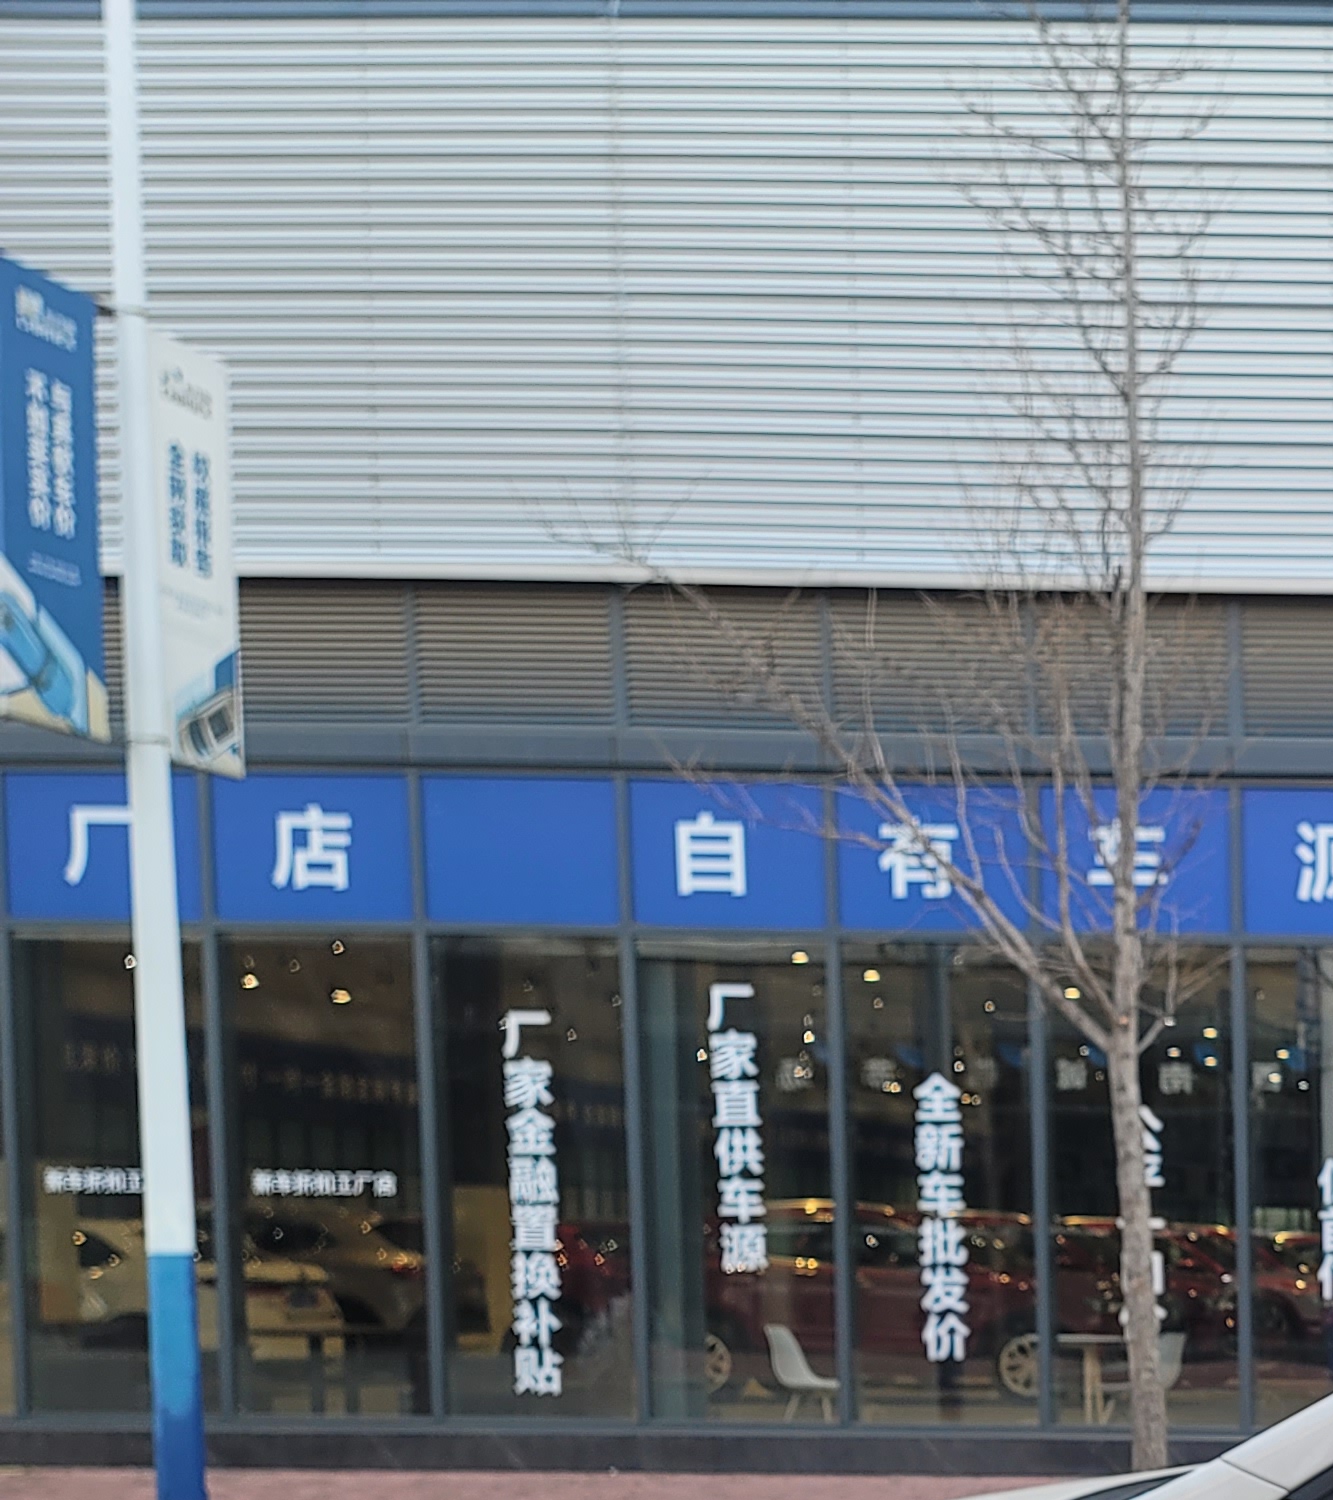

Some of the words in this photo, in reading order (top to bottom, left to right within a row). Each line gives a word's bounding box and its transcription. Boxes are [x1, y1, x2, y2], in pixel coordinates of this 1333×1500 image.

[502, 1009, 564, 1396] 厂家金融置换补贴
[706, 983, 769, 1273] 厂家直供车源
[912, 1072, 971, 1362] 全新车批发价
